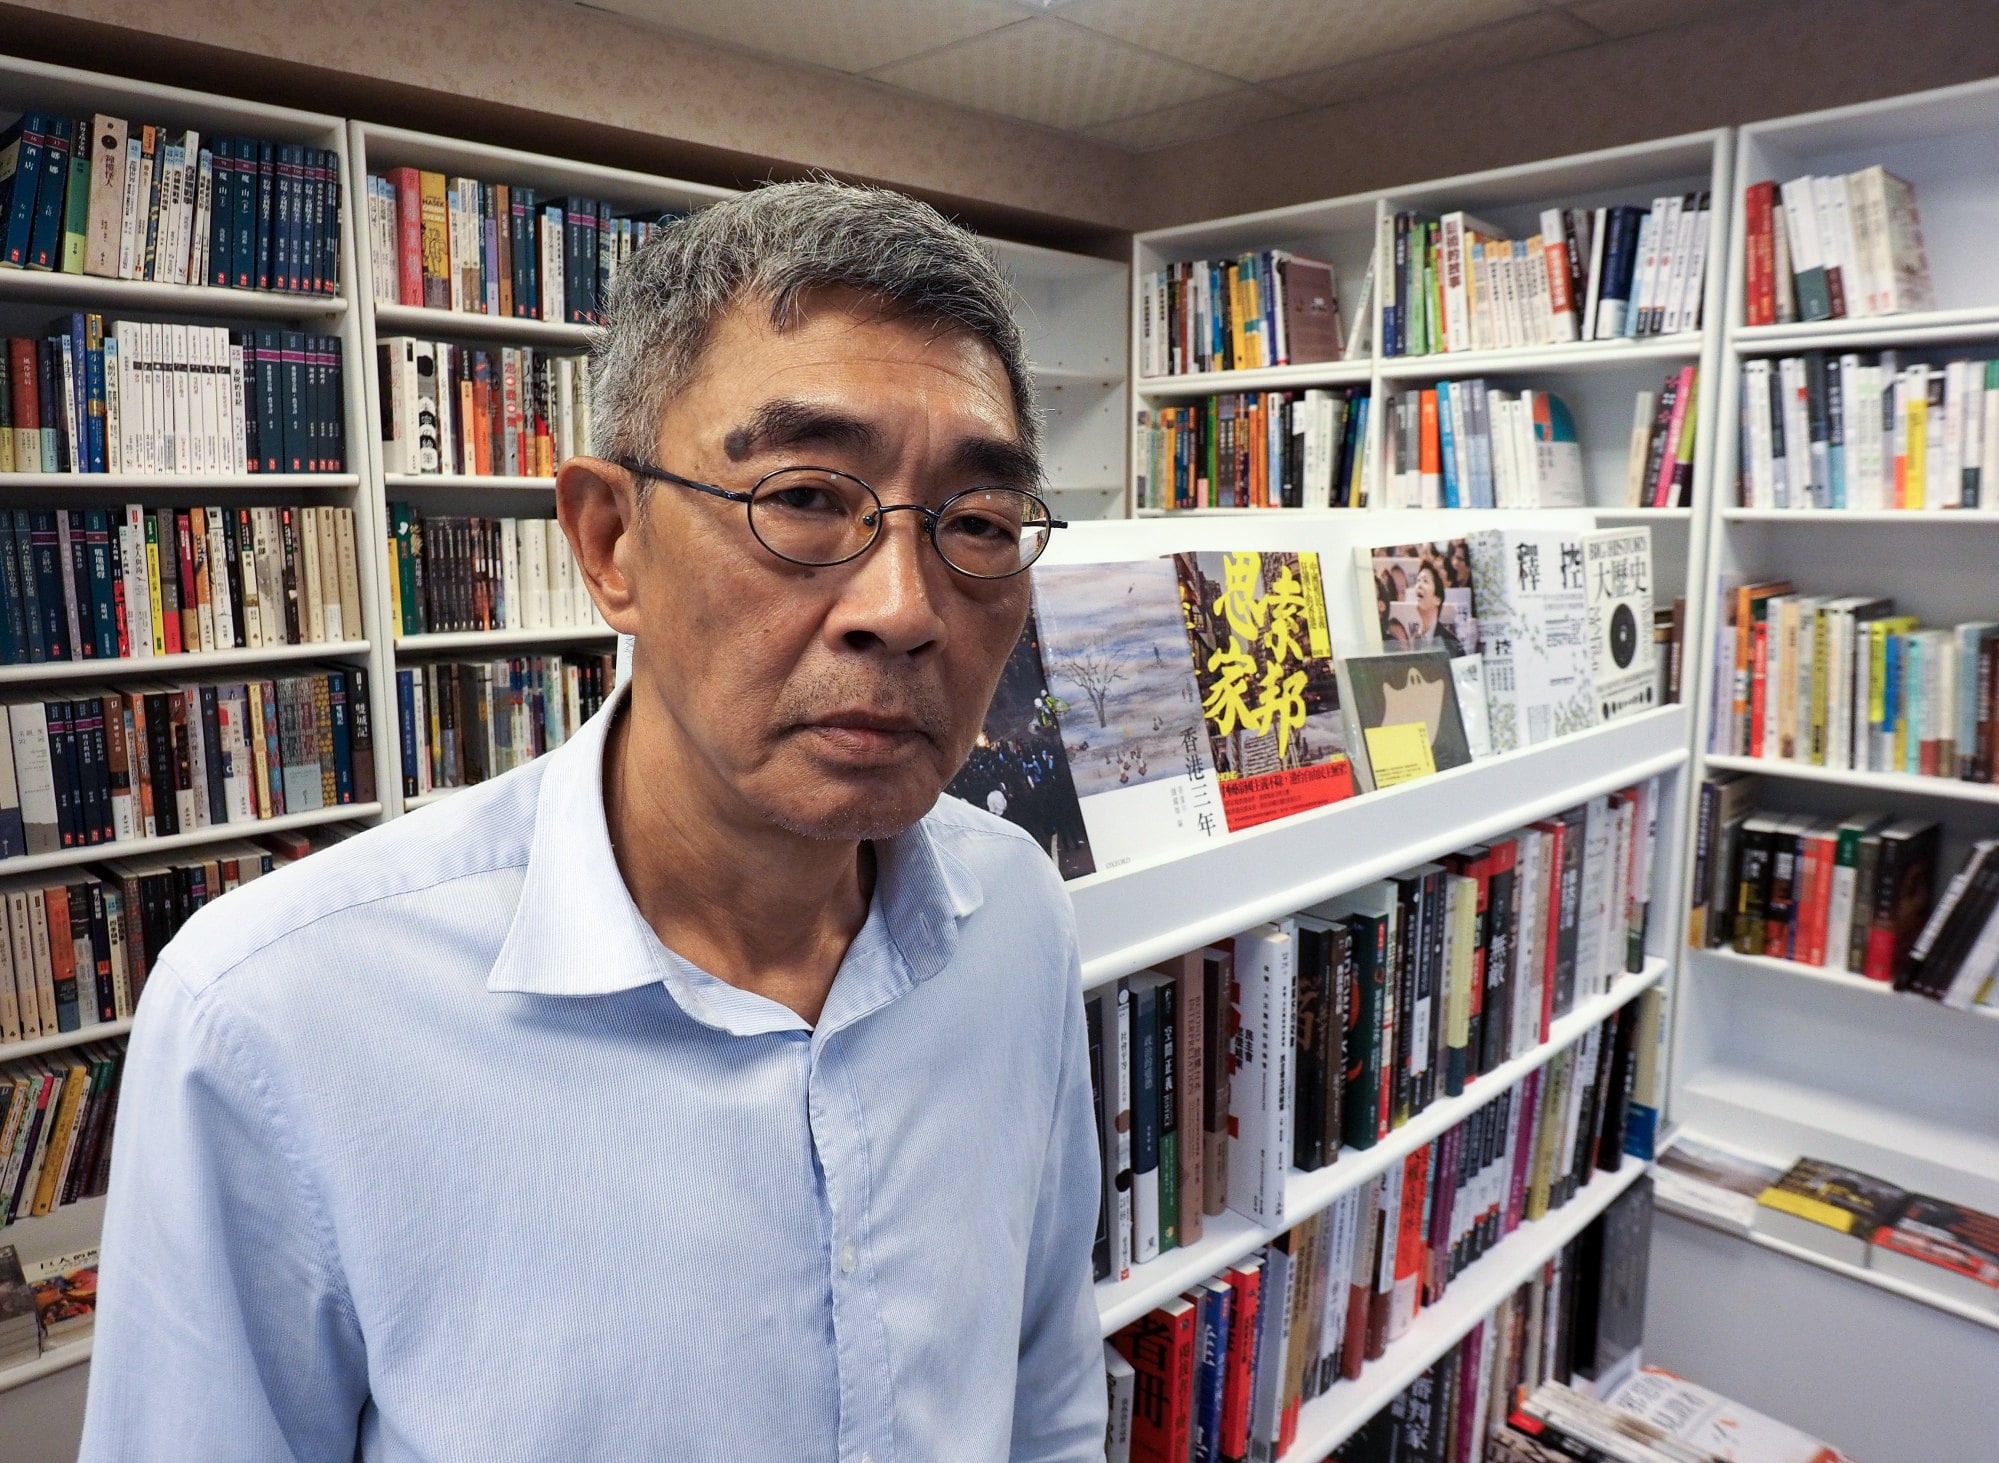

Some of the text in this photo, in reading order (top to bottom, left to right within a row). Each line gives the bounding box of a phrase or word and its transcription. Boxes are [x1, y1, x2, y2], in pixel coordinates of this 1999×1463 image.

[1213, 551, 1306, 667] 思索
[1592, 555, 1648, 603] 大歷史
[1202, 645, 1310, 759] 家邦
[1179, 726, 1216, 837] 香港三年
[1164, 1025, 1173, 1092] 空間正義
